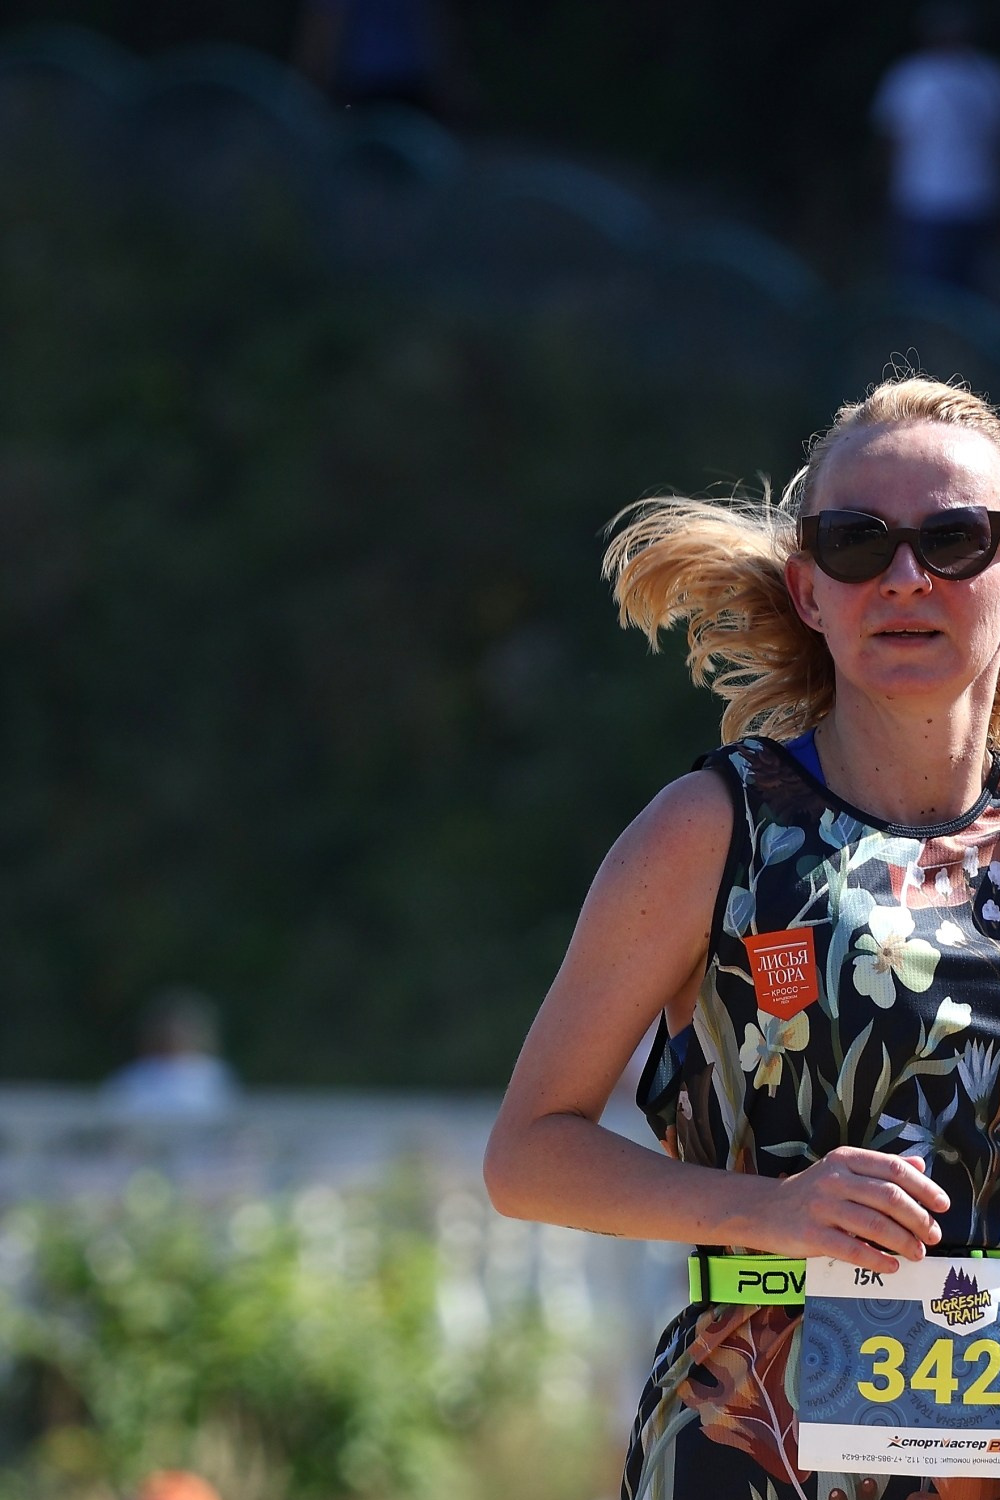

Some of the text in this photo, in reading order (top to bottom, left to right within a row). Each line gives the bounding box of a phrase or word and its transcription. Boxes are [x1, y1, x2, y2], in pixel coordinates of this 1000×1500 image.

[757, 949, 808, 972] ЛИСЬЯ
[768, 967, 806, 986] ГОРА
[771, 985, 799, 997] КРОСС
[931, 1290, 991, 1314] UGRESHA
[946, 1305, 984, 1325] TRAIL
[841, 1453, 902, 1463] +7-985-824-6424
[905, 1455, 919, 1463] 112,
[922, 1456, 937, 1464] 103,
[940, 1457, 971, 1465] помощи:
